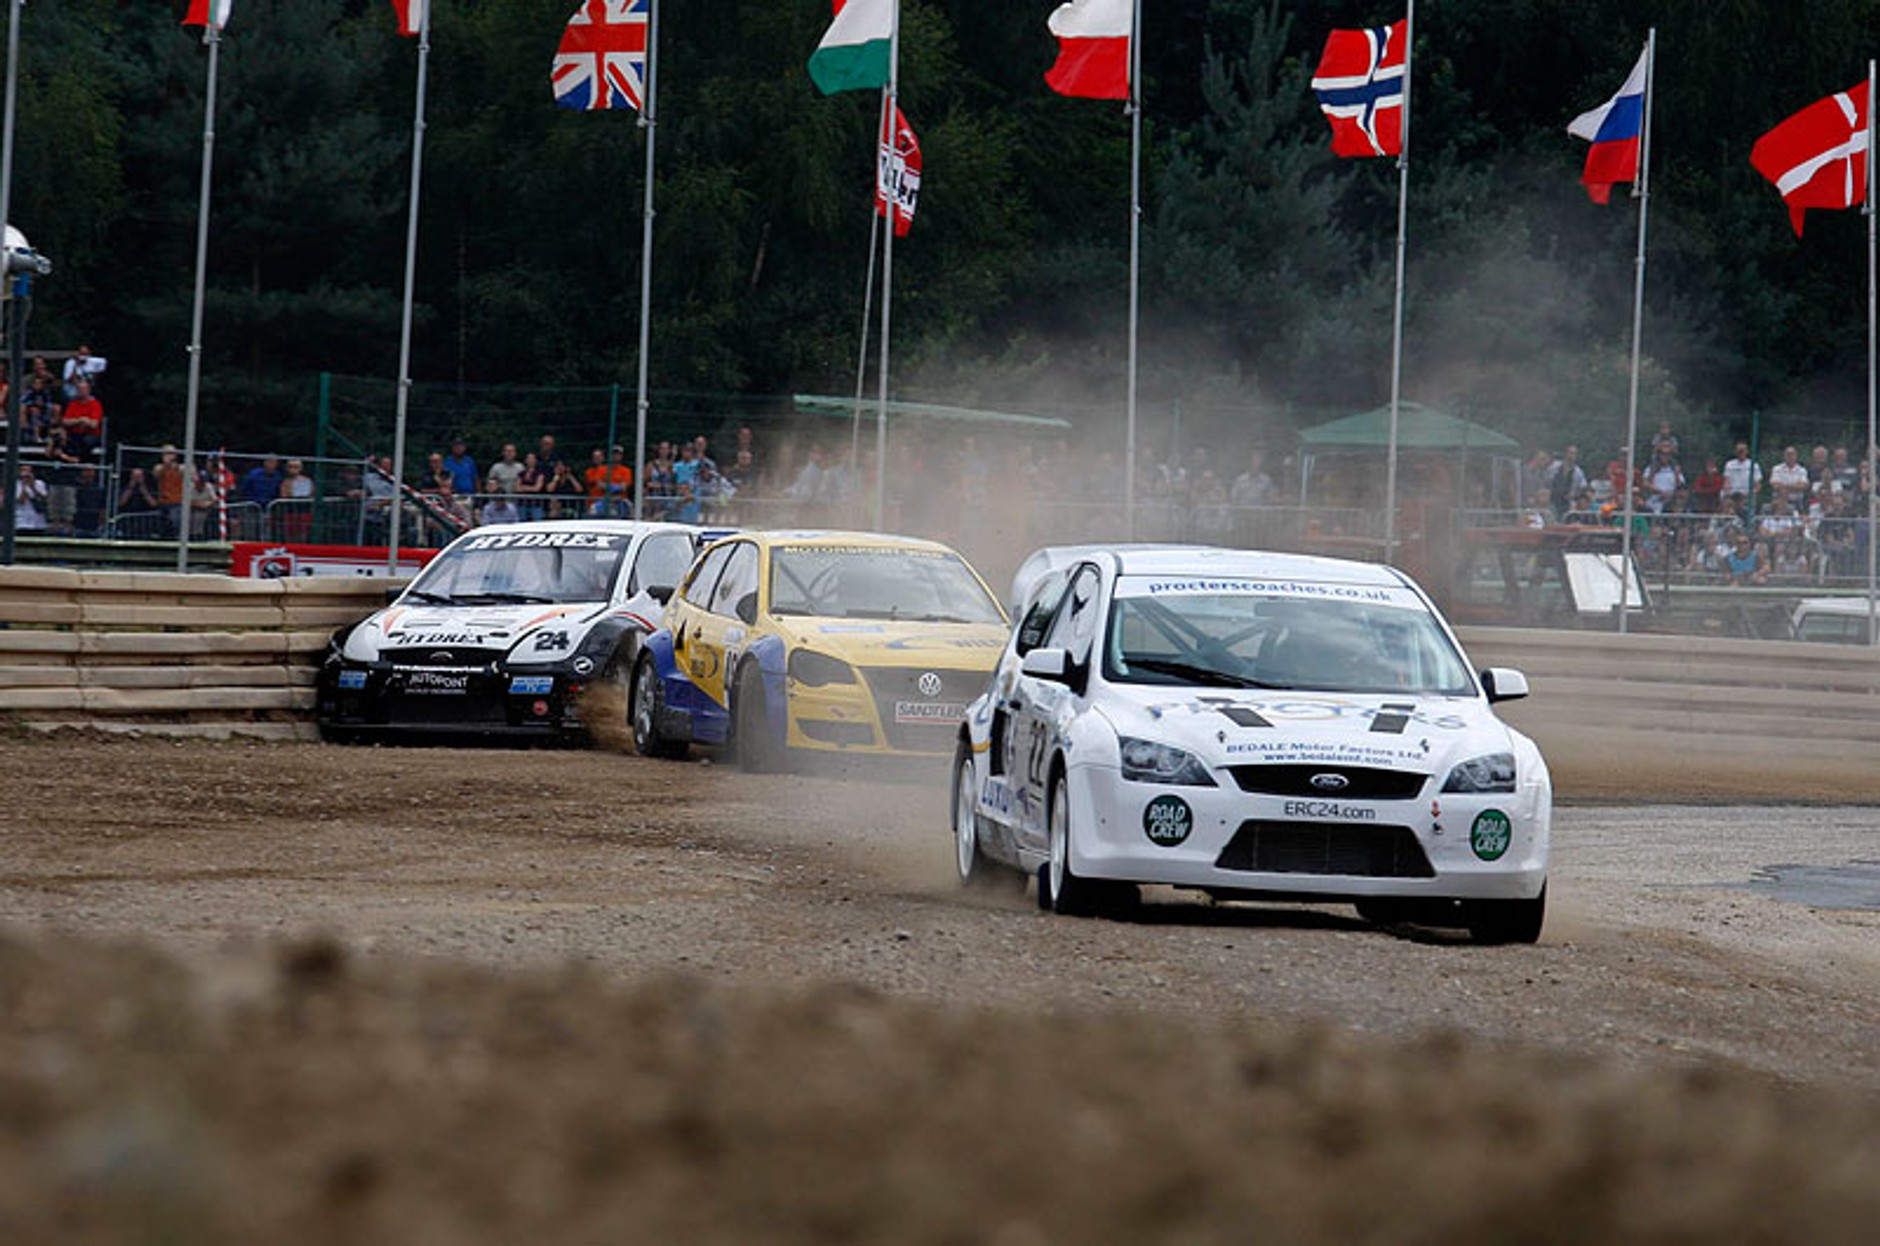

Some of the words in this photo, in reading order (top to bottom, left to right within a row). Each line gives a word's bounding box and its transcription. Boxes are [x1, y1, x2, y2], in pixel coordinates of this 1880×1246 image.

[465, 533, 619, 550] HYDREX
[1149, 581, 1391, 601] procterscoaches.co.uk
[534, 630, 571, 651] 24
[408, 671, 469, 688] AUTOPOINT
[1226, 742, 1285, 753] BEDALE
[1289, 742, 1335, 752] Motor
[1339, 744, 1394, 757] Factors
[1149, 804, 1186, 821] ROAD
[1285, 801, 1376, 820] ERC24.com
[1150, 820, 1189, 838] CREW
[1476, 817, 1507, 835] ROAD
[1476, 833, 1507, 852] CREW
